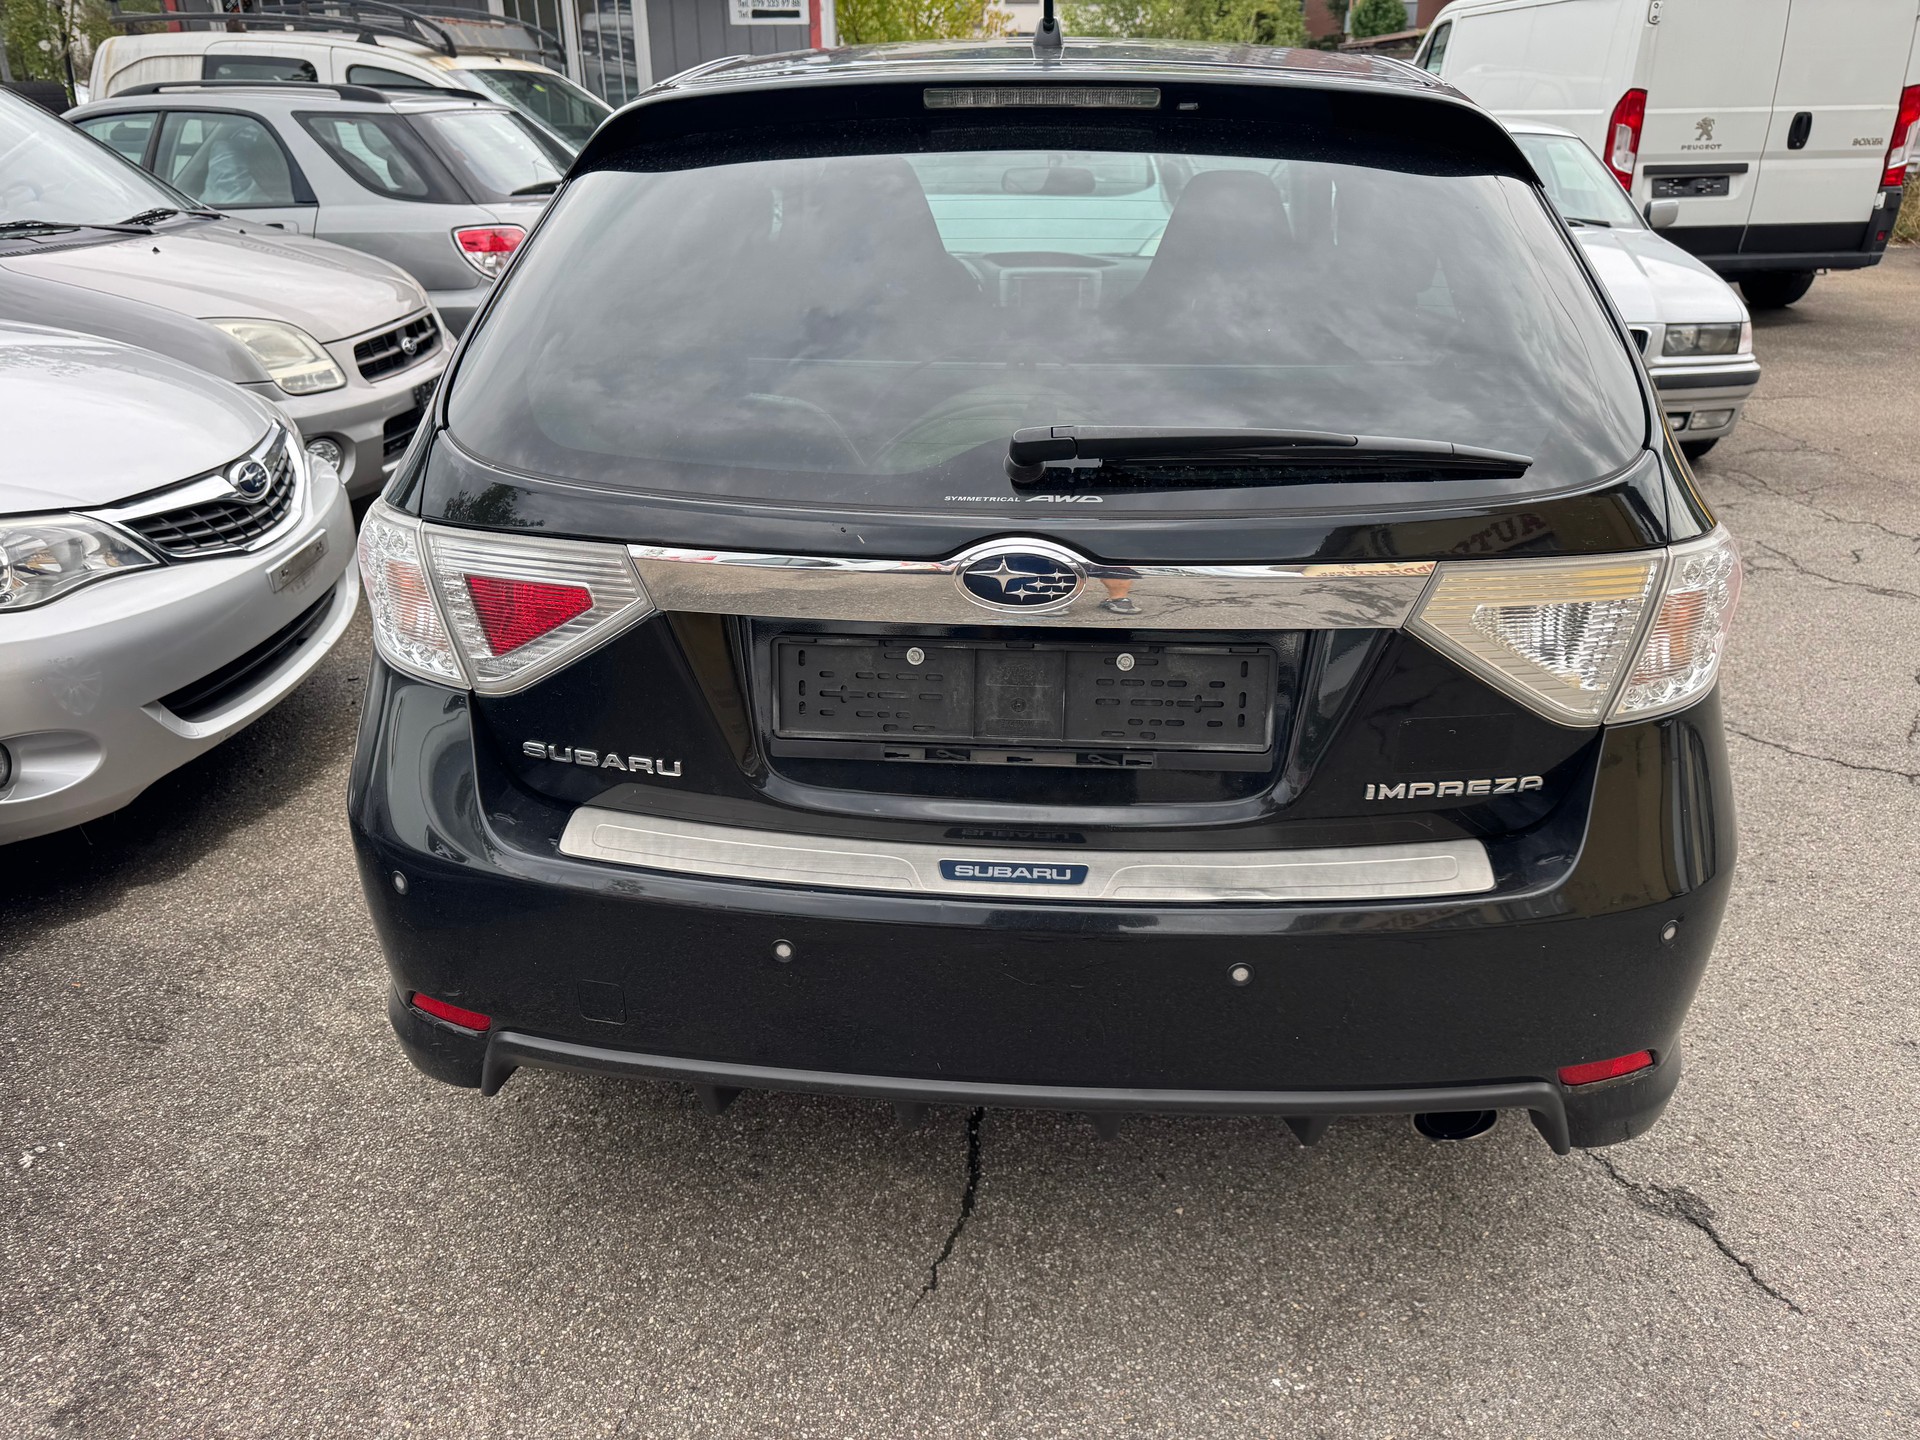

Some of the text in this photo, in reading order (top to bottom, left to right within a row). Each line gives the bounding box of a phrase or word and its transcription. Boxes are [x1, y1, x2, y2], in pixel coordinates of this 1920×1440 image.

[1680, 143, 1722, 151] PEUGEOT
[1852, 137, 1884, 146] BOXER
[944, 495, 1104, 503] SYMMETRICAL AWD
[522, 739, 683, 777] SUBARU
[1365, 775, 1544, 800] IMPREZA
[954, 865, 1072, 881] SUBARU
